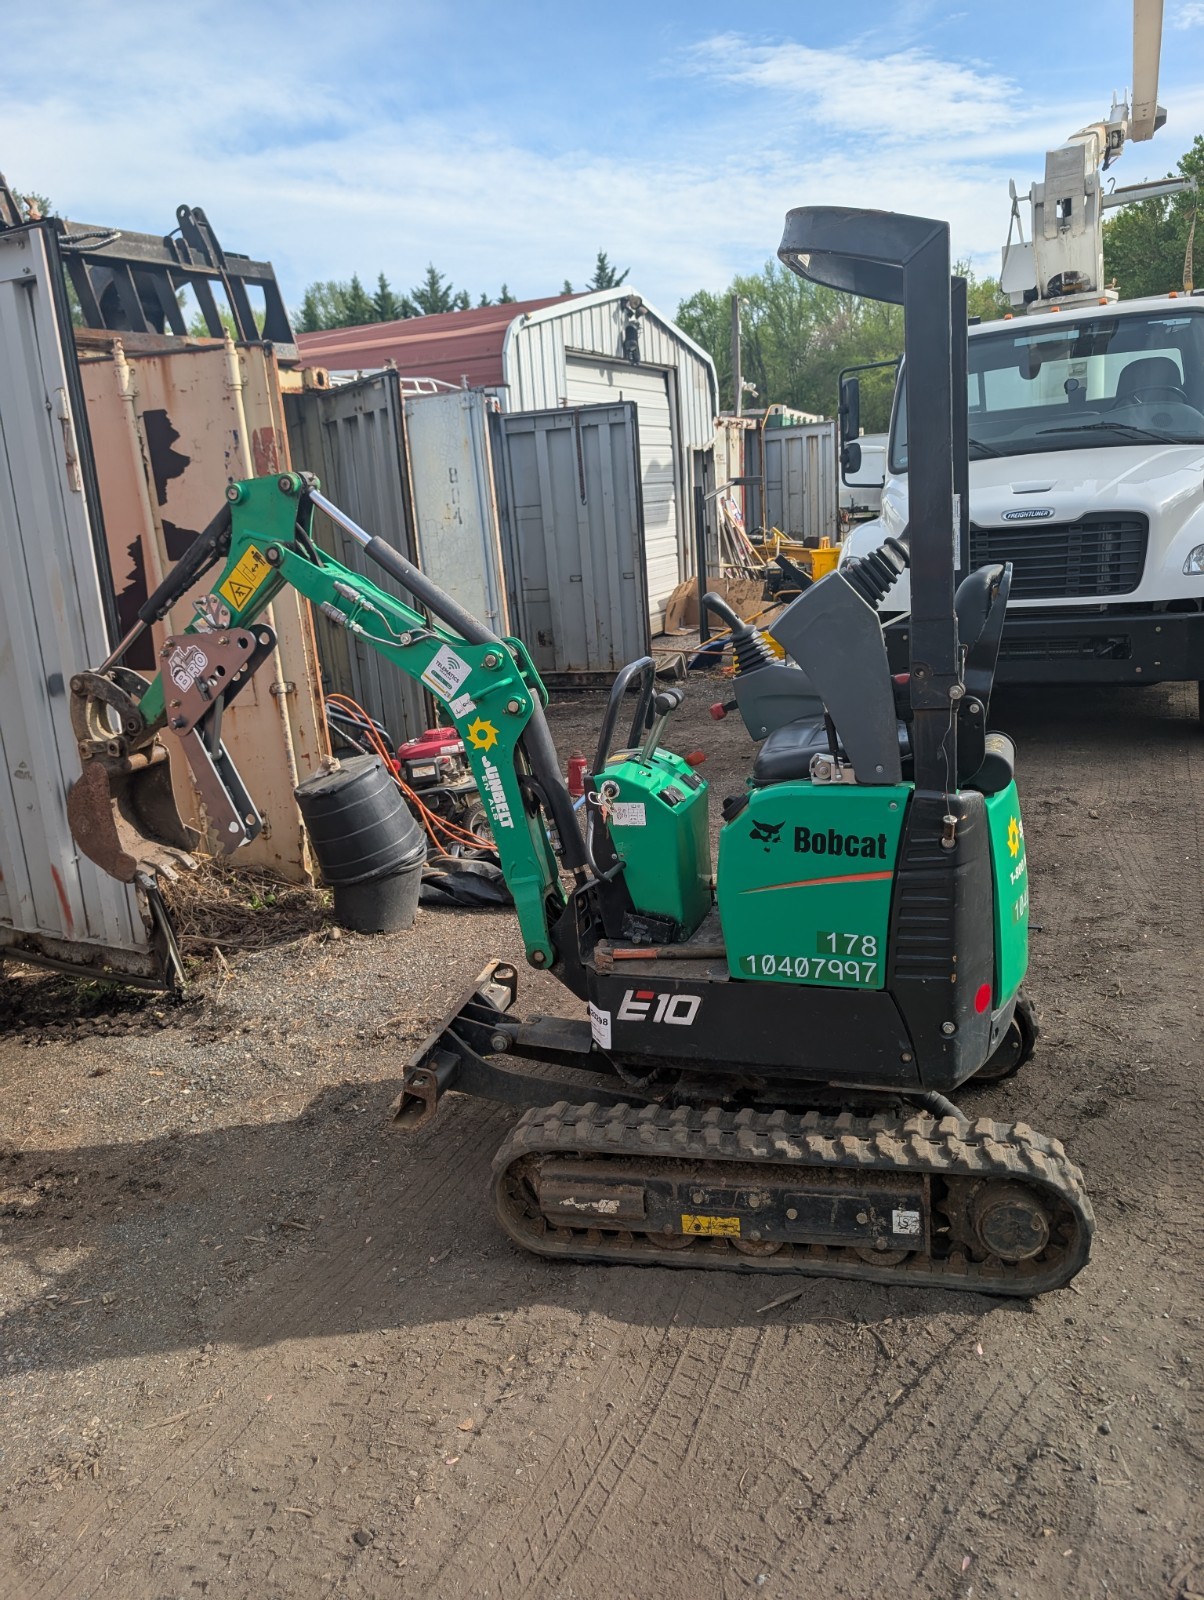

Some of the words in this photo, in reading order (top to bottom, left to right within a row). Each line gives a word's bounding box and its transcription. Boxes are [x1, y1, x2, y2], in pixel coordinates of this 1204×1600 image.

[1007, 510, 1049, 519] FREIGHTLINER
[174, 652, 207, 691] BRO
[435, 659, 460, 684] TELEMATICS
[794, 826, 887, 860] Bobcat
[826, 932, 877, 957] 178
[746, 954, 877, 983] 10407997
[616, 989, 702, 1026] E10
